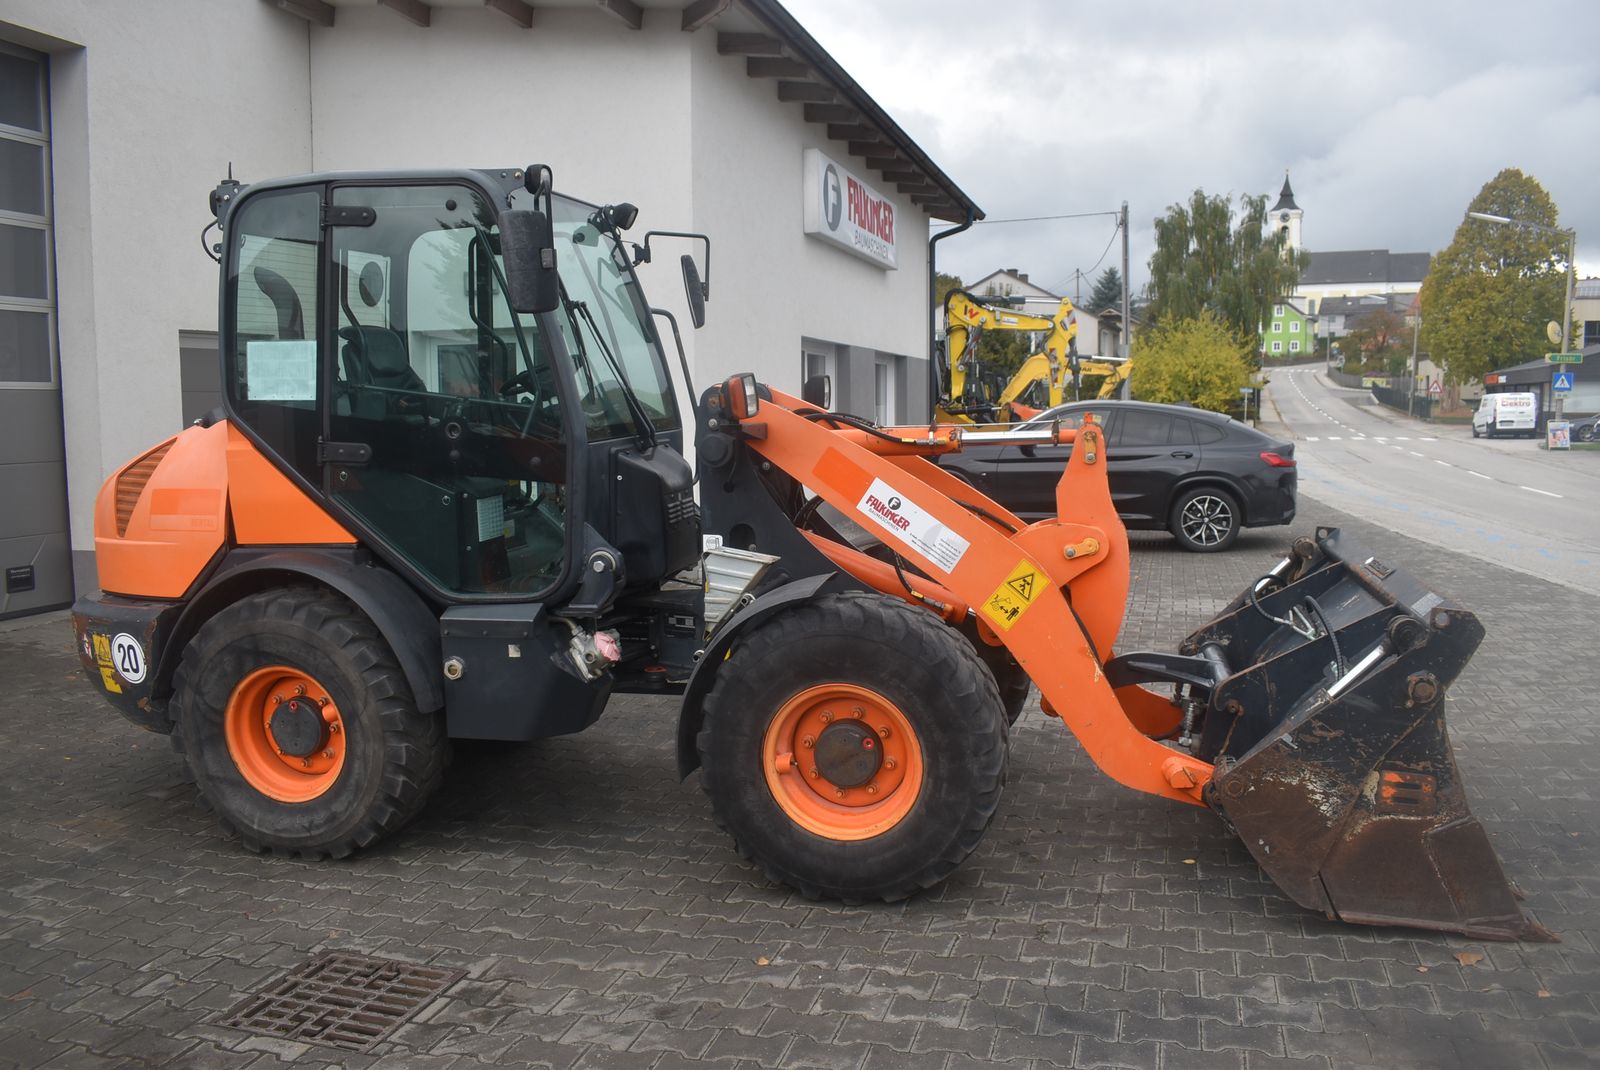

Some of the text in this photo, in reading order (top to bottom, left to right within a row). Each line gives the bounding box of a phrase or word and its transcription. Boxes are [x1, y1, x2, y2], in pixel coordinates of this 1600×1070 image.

[847, 175, 894, 246] FALKINGER
[865, 494, 911, 531] FALKINGER
[117, 643, 140, 674] 20
